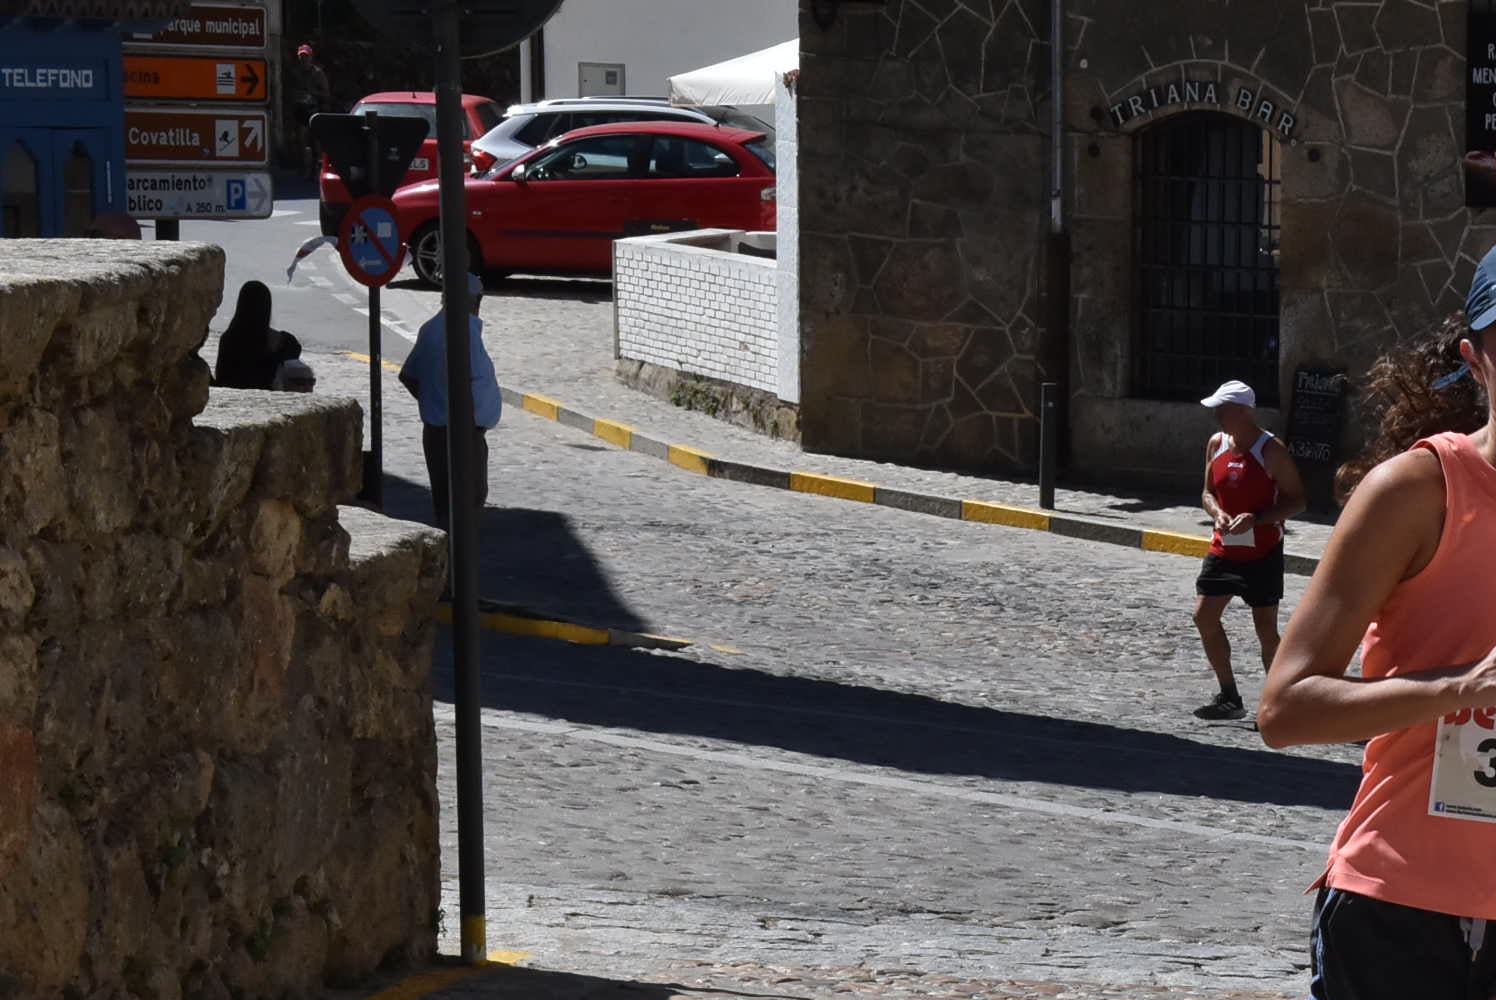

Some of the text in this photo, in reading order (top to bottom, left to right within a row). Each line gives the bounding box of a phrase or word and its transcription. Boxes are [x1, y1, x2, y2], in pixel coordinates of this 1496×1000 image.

[205, 17, 260, 38] municipal
[1, 67, 93, 88] TELEFONO
[1110, 80, 1296, 136] TRIANA BAR
[128, 127, 200, 146] Covatilla
[230, 182, 243, 208] P
[196, 202, 212, 213] 250
